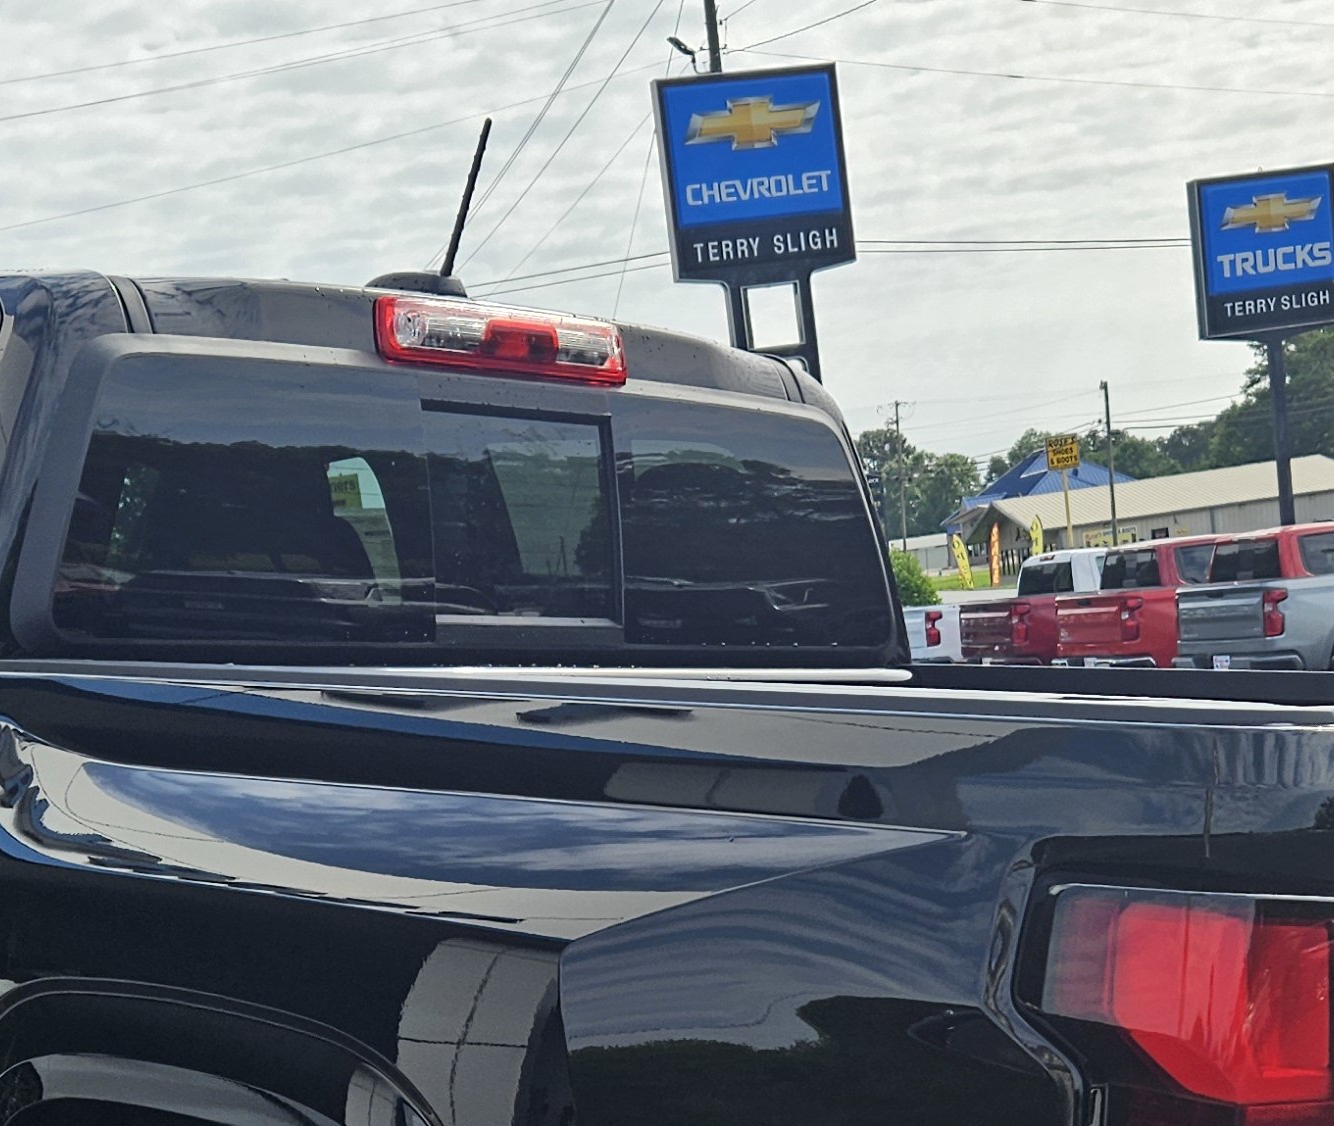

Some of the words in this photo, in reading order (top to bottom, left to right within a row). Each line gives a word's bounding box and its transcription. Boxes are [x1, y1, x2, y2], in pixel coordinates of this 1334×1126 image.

[686, 170, 831, 206] CHEVROLET
[693, 237, 760, 263] TERRY
[773, 227, 838, 254] SLIGH
[1217, 241, 1332, 278] TRUCKS
[1224, 297, 1276, 317] TERRY
[1280, 289, 1330, 311] SLIGH
